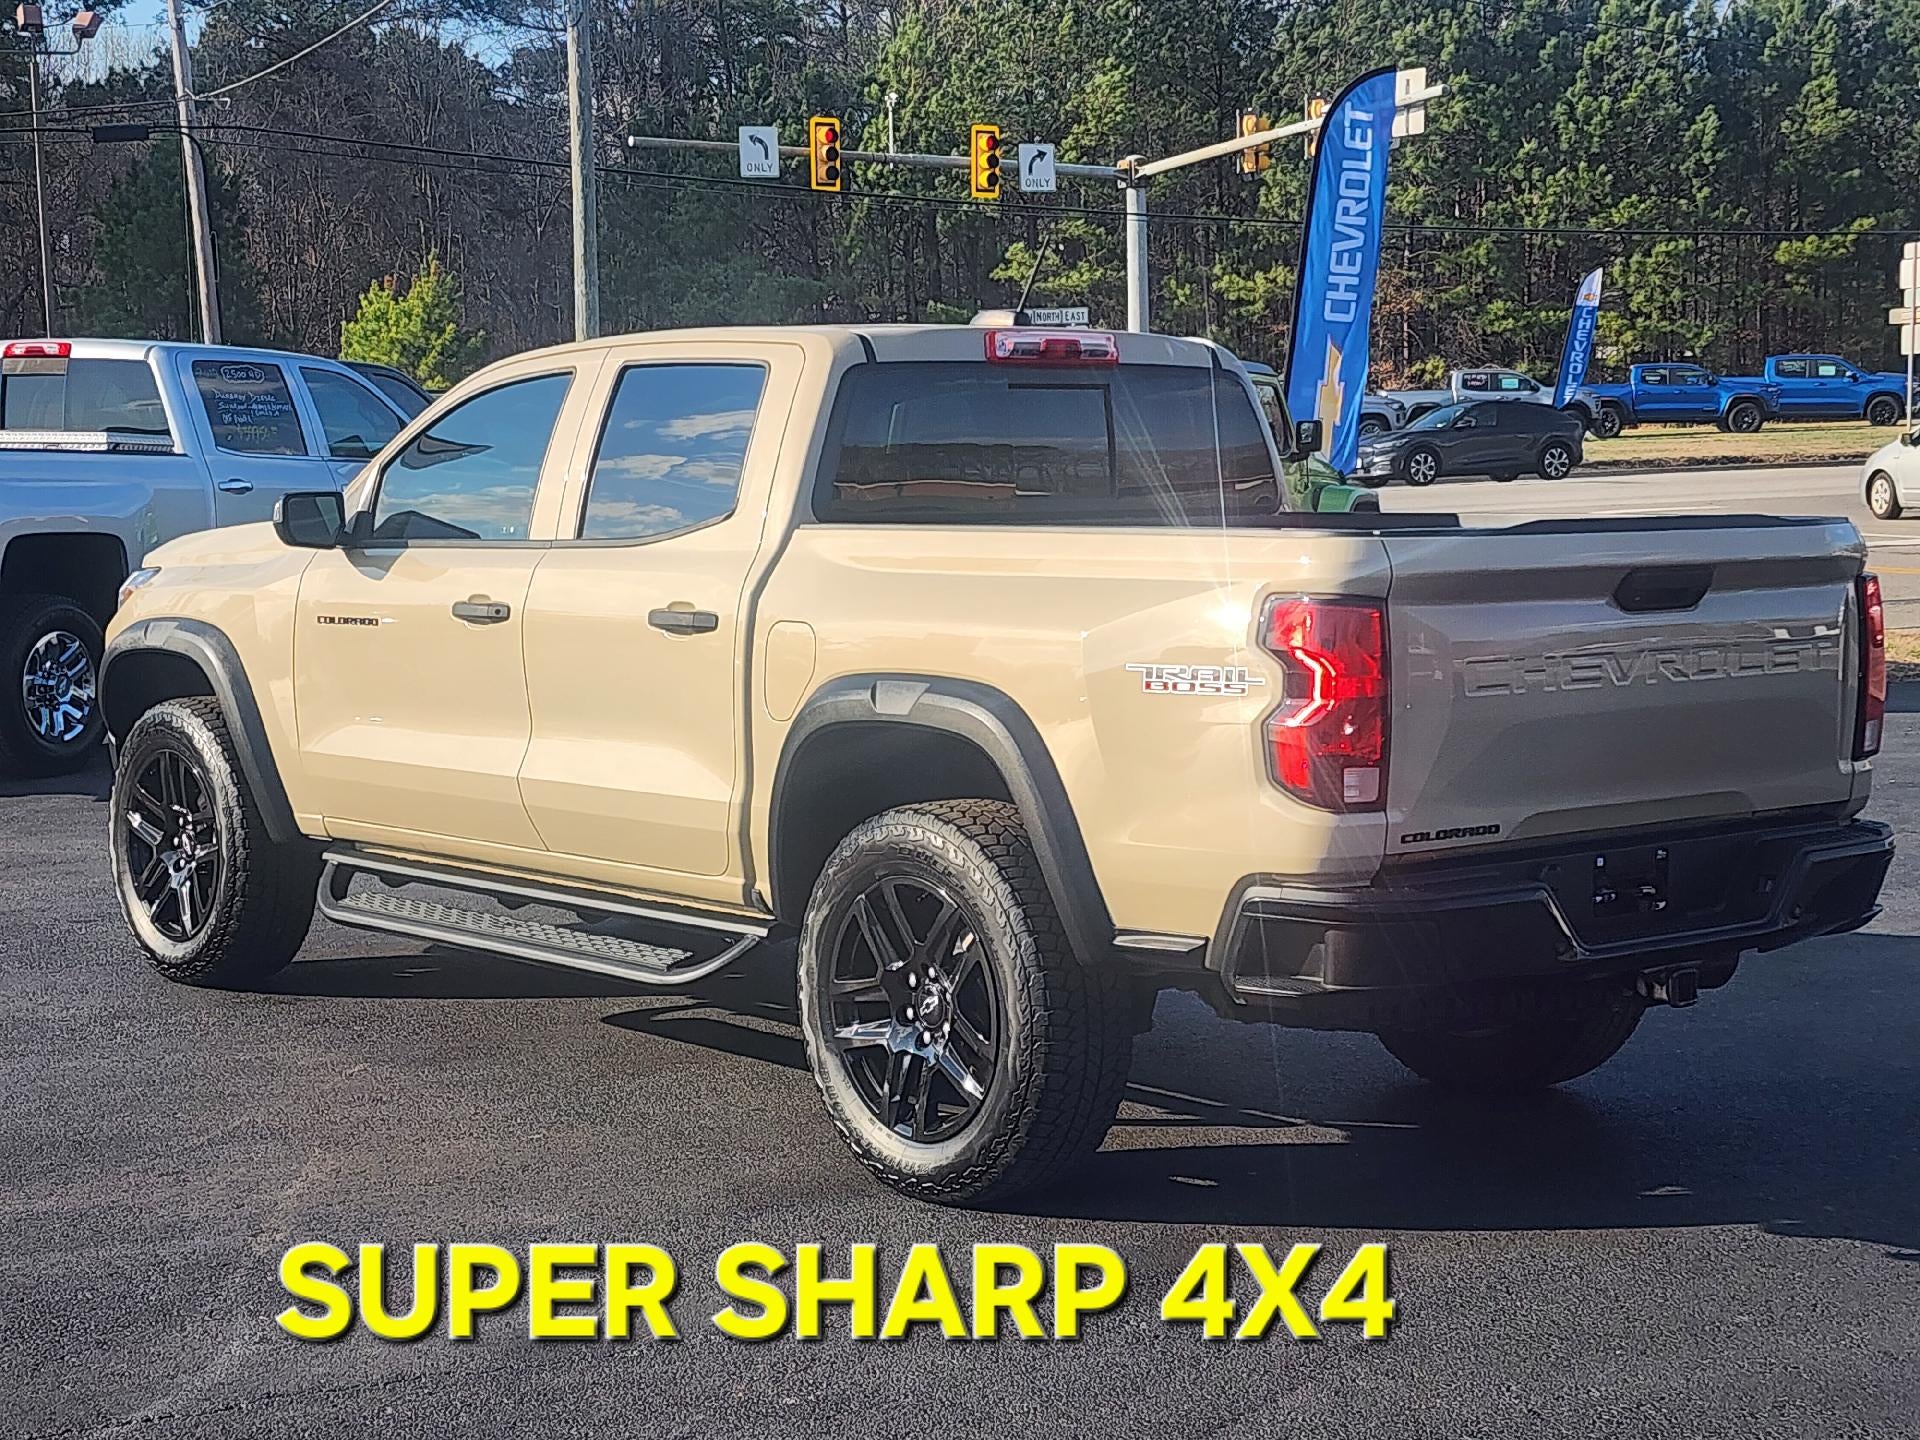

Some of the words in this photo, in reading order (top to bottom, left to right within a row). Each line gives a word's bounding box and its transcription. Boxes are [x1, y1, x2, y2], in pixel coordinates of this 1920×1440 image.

[746, 162, 774, 173] ONLY
[1025, 177, 1051, 188] ONLY
[1323, 100, 1374, 323] CHEVROLET
[1064, 310, 1085, 321] EAST
[1562, 307, 1593, 405] CHEVROLET
[224, 369, 246, 379] 2500
[316, 615, 379, 627] COLORADO
[1124, 663, 1266, 682] TRAIL
[1464, 640, 1841, 697] CHEVROLET
[1143, 680, 1248, 696] BOSS
[1400, 823, 1501, 844] COLORADO
